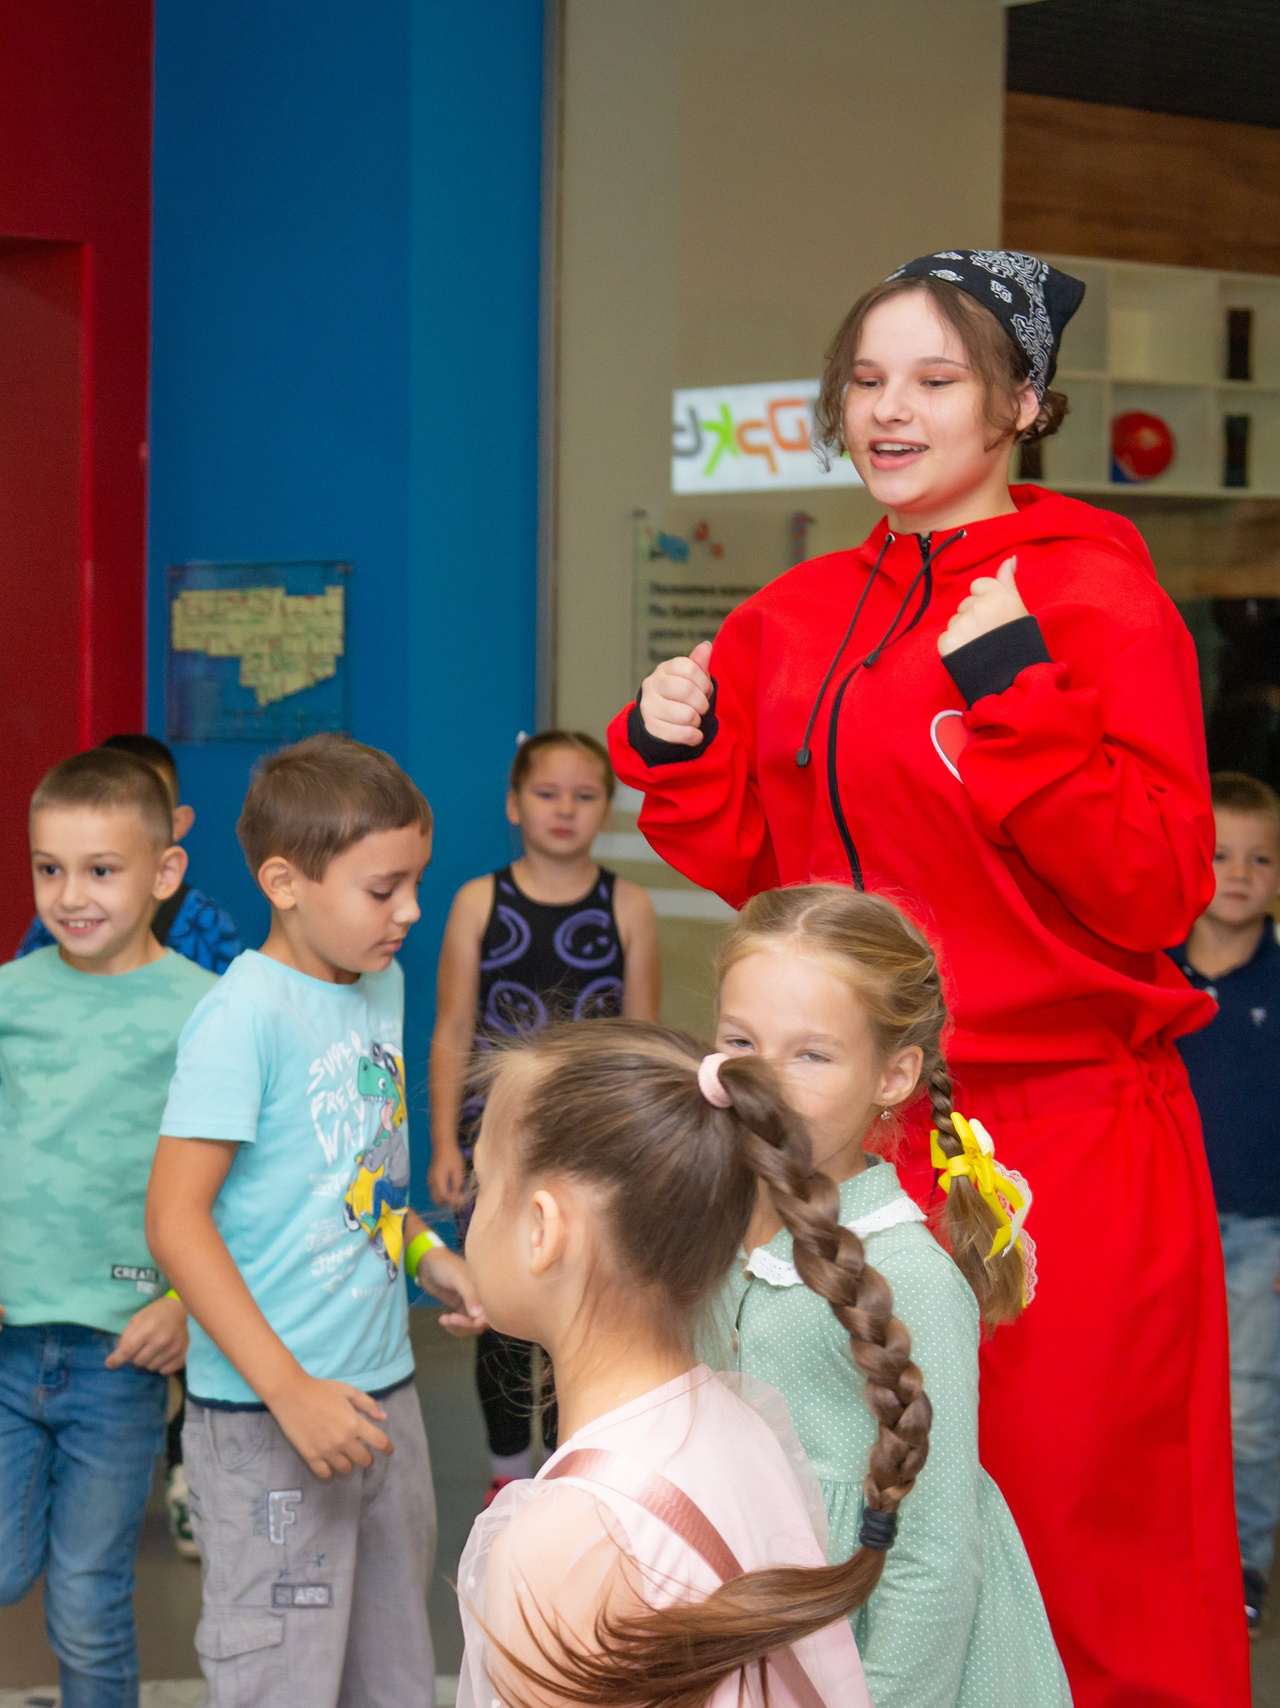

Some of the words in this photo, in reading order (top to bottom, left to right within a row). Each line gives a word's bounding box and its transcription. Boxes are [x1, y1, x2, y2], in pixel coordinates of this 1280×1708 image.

[311, 1077, 358, 1122] FREE
[315, 1099, 366, 1167] WAY
[267, 1490, 303, 1545] F
